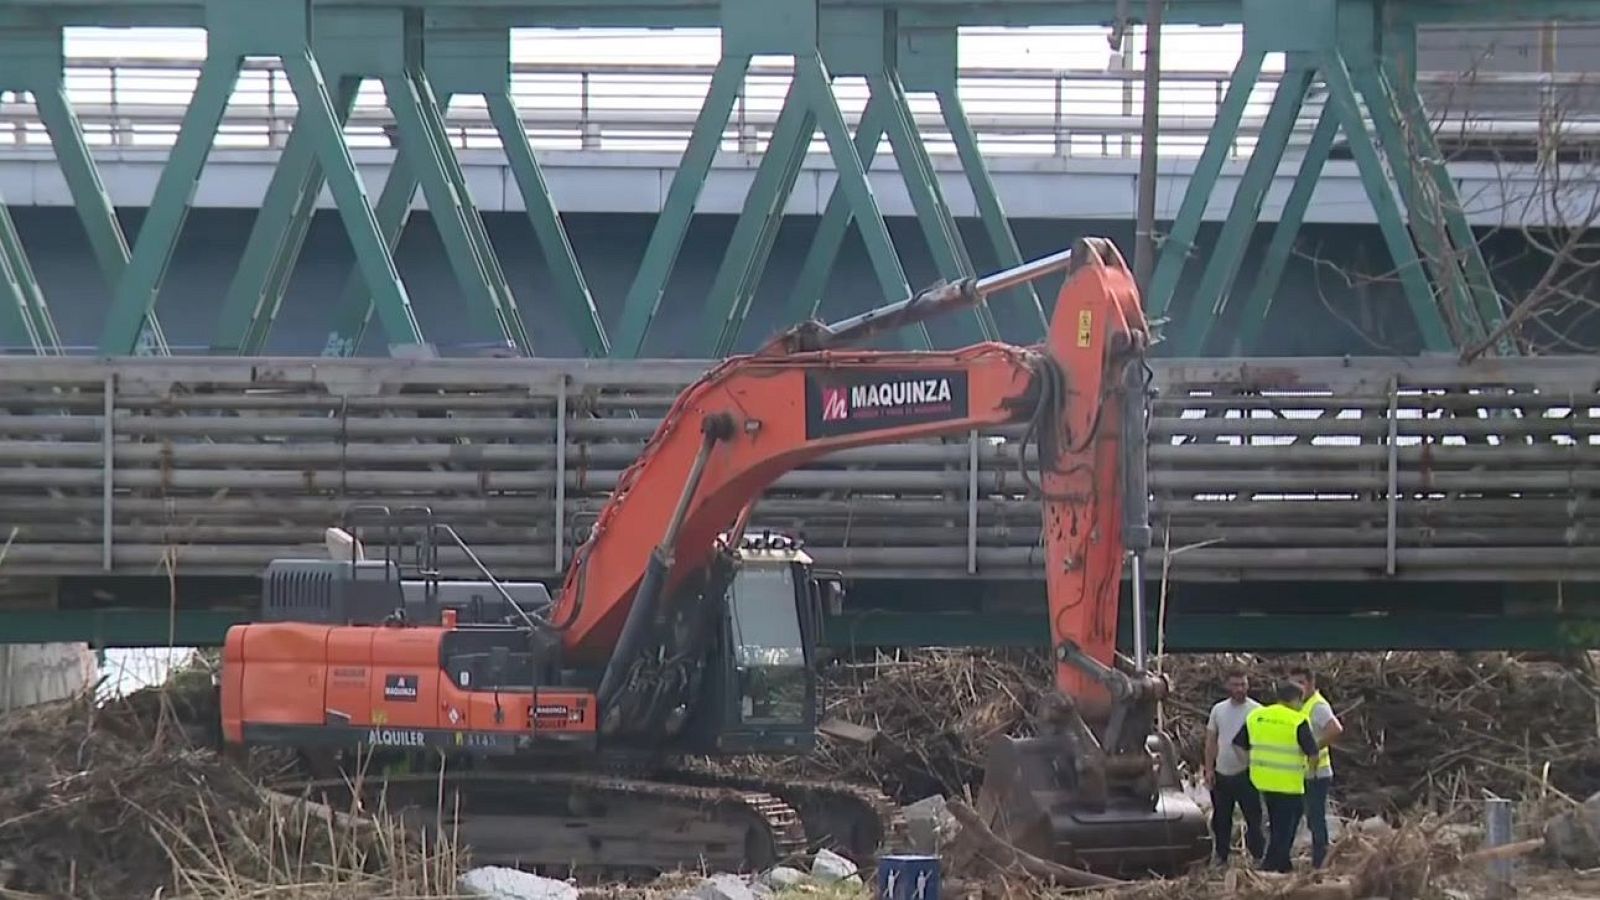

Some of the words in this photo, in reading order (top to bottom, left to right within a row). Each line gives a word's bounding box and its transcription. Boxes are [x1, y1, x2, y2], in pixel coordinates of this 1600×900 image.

[851, 378, 952, 408] MAQUINZA
[384, 687, 417, 697] MAQUINZA
[526, 719, 567, 729] AQUILER
[368, 729, 425, 747] ALQUILER
